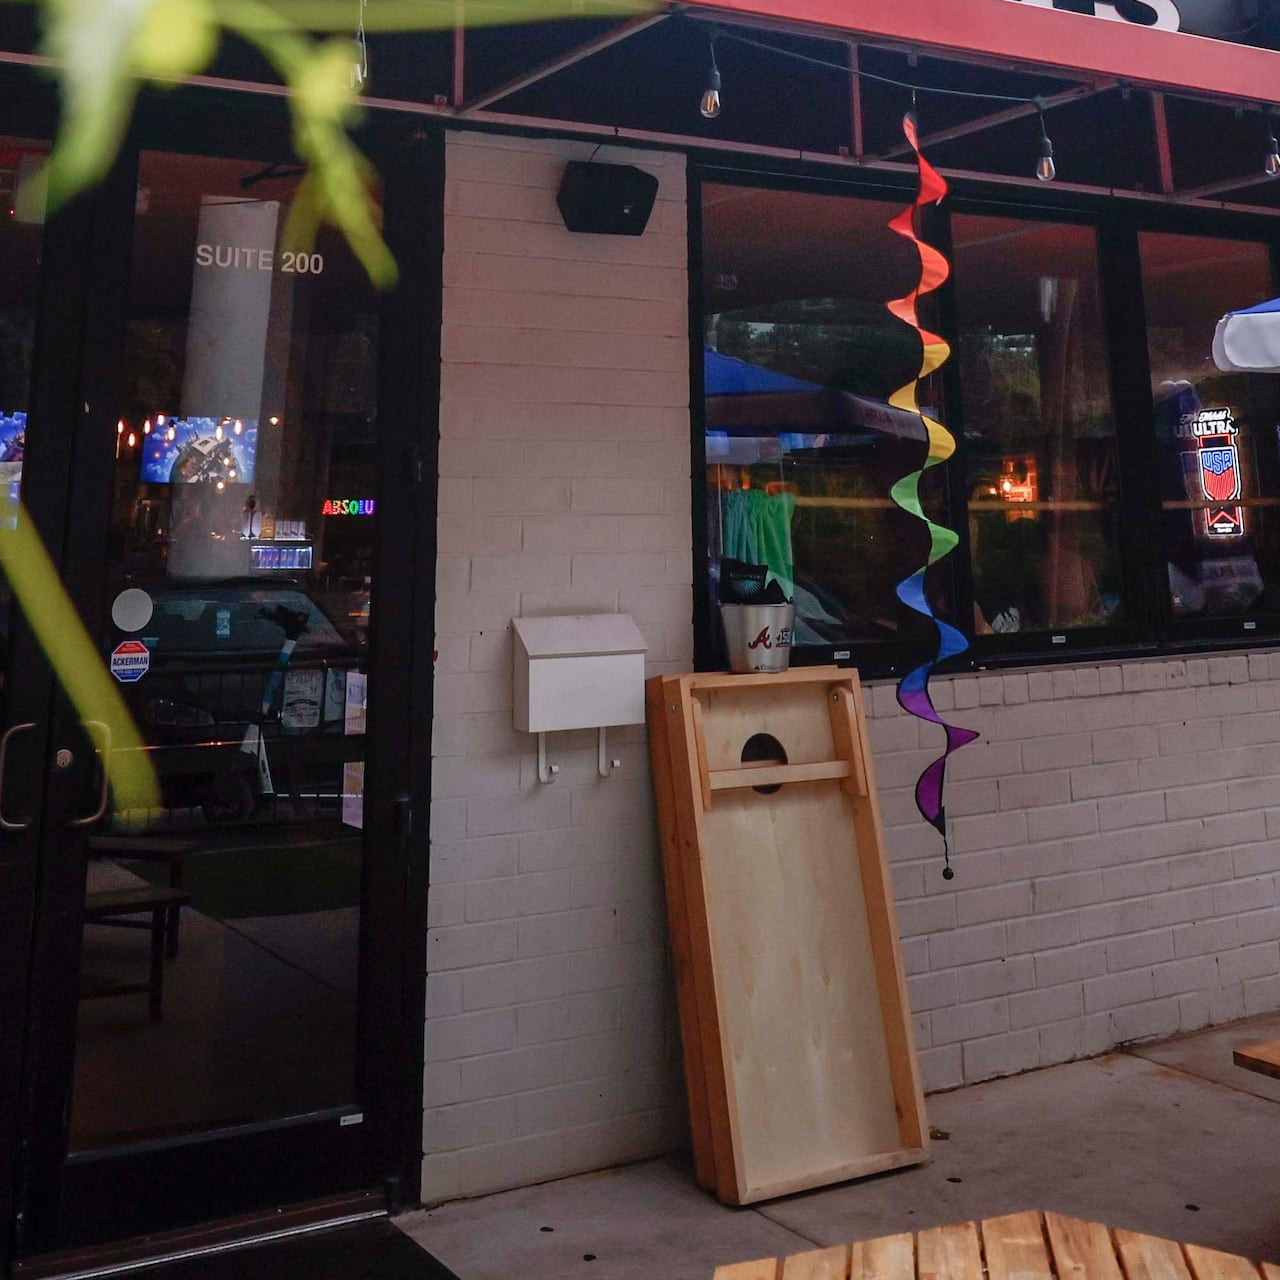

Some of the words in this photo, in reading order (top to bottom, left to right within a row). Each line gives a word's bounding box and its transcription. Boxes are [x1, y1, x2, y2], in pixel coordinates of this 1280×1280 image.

[196, 245, 273, 270] SUITE
[281, 251, 324, 274] 200
[1193, 420, 1235, 435] ULTRA
[1202, 451, 1233, 475] USA
[322, 499, 374, 515] ABSOLU
[113, 656, 148, 666] ACKERMAN
